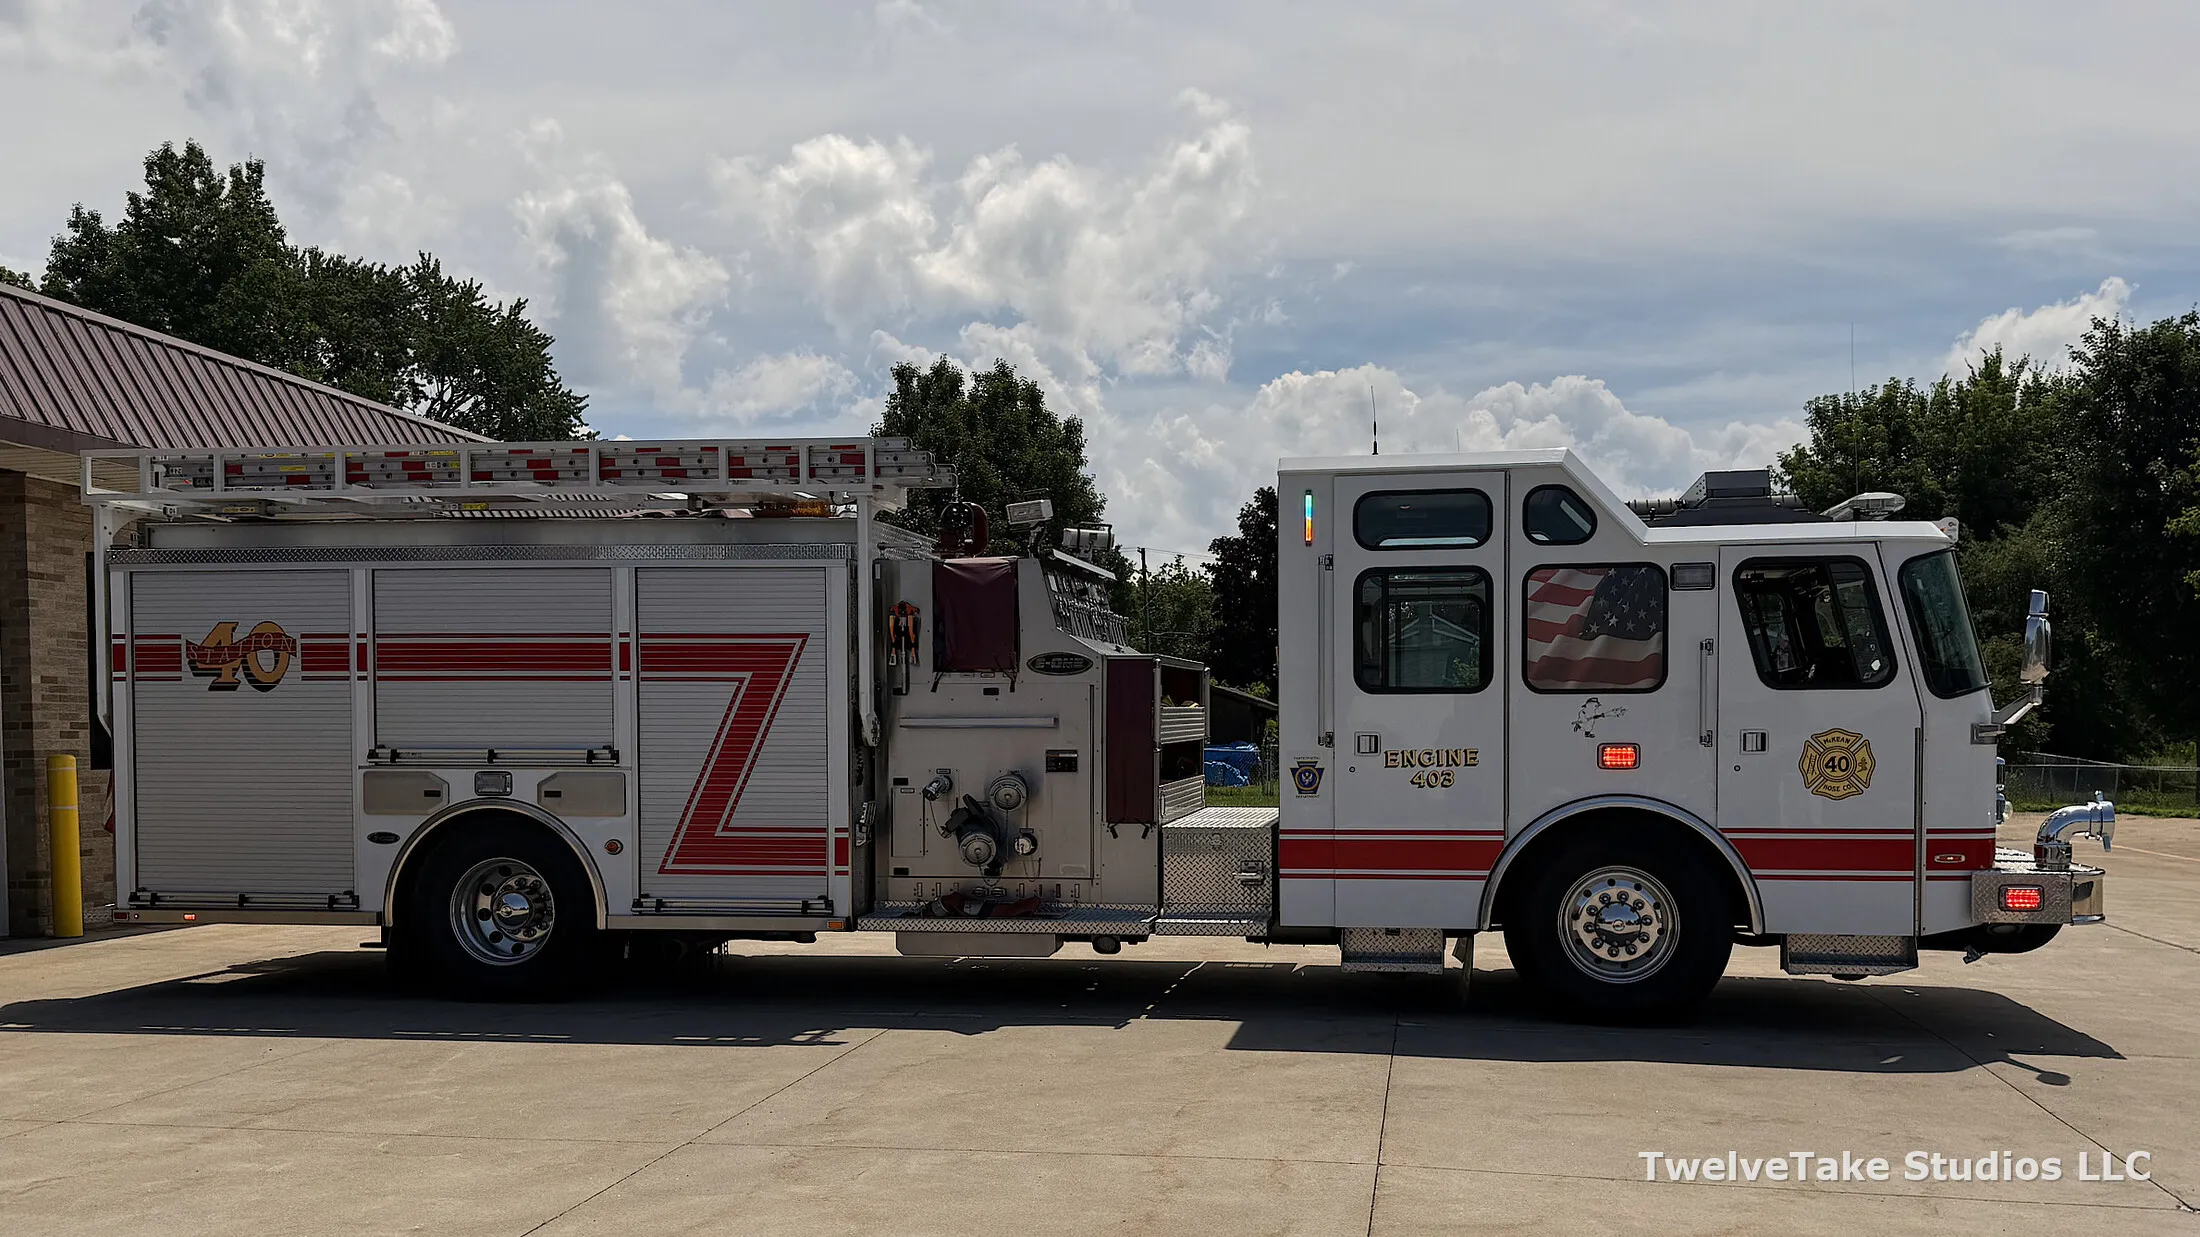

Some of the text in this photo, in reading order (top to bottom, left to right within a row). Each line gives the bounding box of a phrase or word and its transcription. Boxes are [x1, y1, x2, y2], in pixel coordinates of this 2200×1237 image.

[187, 621, 291, 692] 40
[189, 632, 293, 664] STATION
[1384, 748, 1479, 768] ENGINE
[1824, 755, 1850, 773] 40
[1409, 769, 1455, 788] 403
[1823, 784, 1841, 792] HOSE
